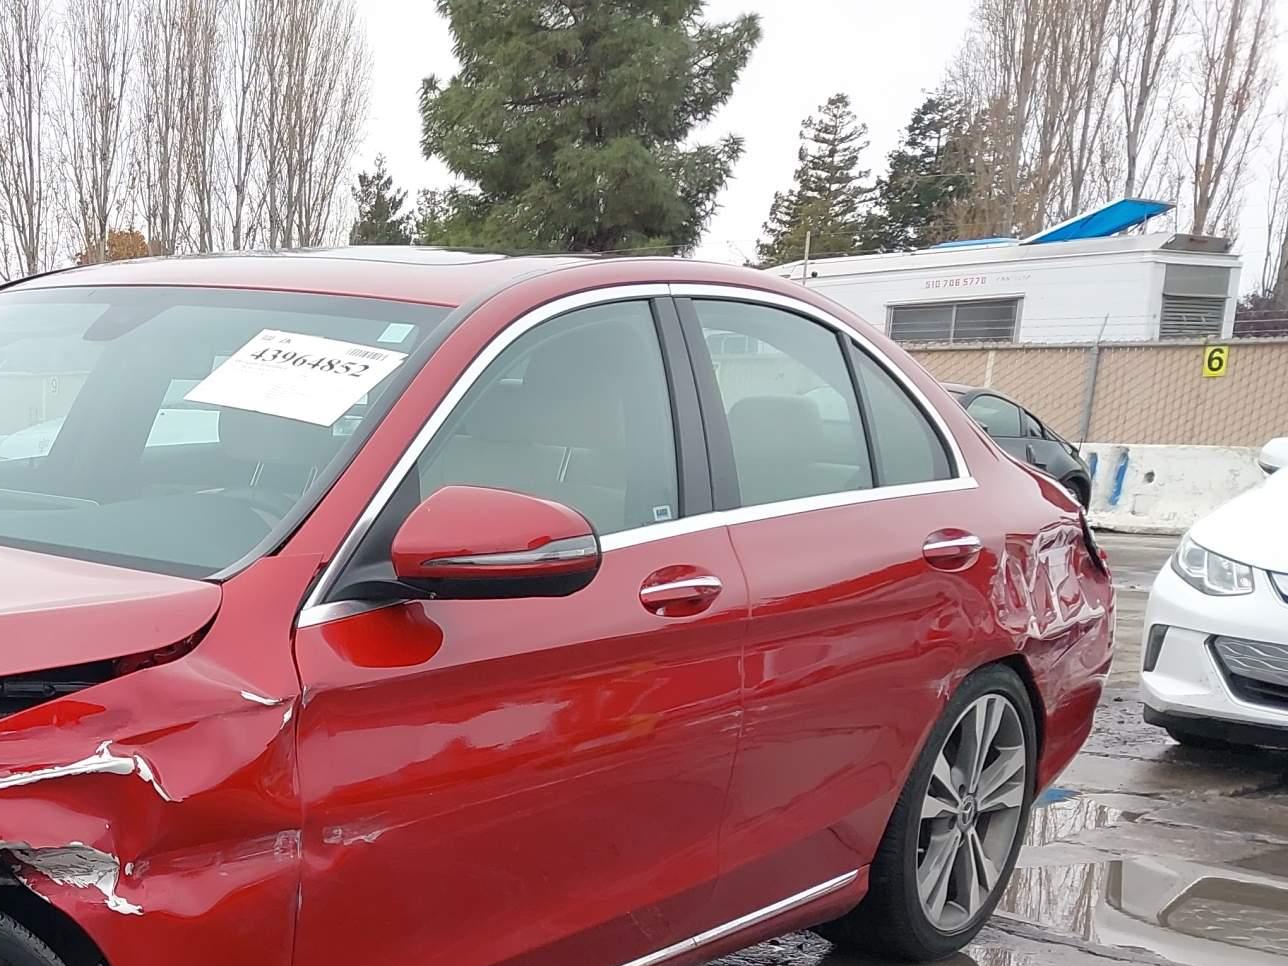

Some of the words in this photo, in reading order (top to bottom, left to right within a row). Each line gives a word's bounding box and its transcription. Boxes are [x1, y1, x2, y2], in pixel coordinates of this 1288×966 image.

[925, 280, 940, 289] 510
[250, 348, 370, 378] 43964852
[1207, 347, 1224, 372] 6
